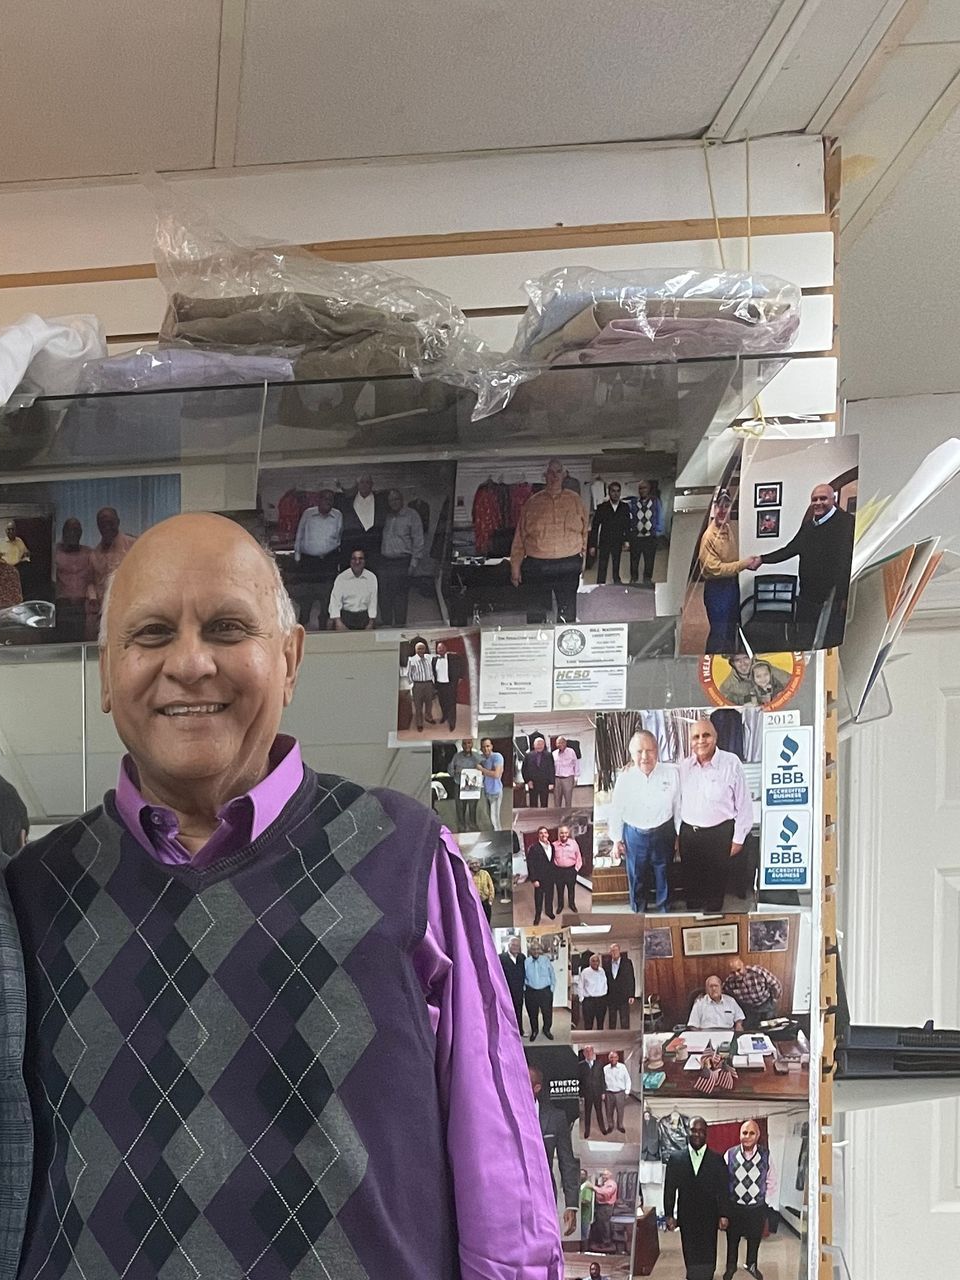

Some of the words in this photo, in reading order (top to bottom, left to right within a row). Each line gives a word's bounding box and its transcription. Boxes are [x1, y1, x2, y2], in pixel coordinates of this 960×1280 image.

[702, 654, 712, 677] HELP
[767, 714, 794, 725] 2012
[771, 772, 804, 784] BBB
[770, 852, 803, 864] BBB
